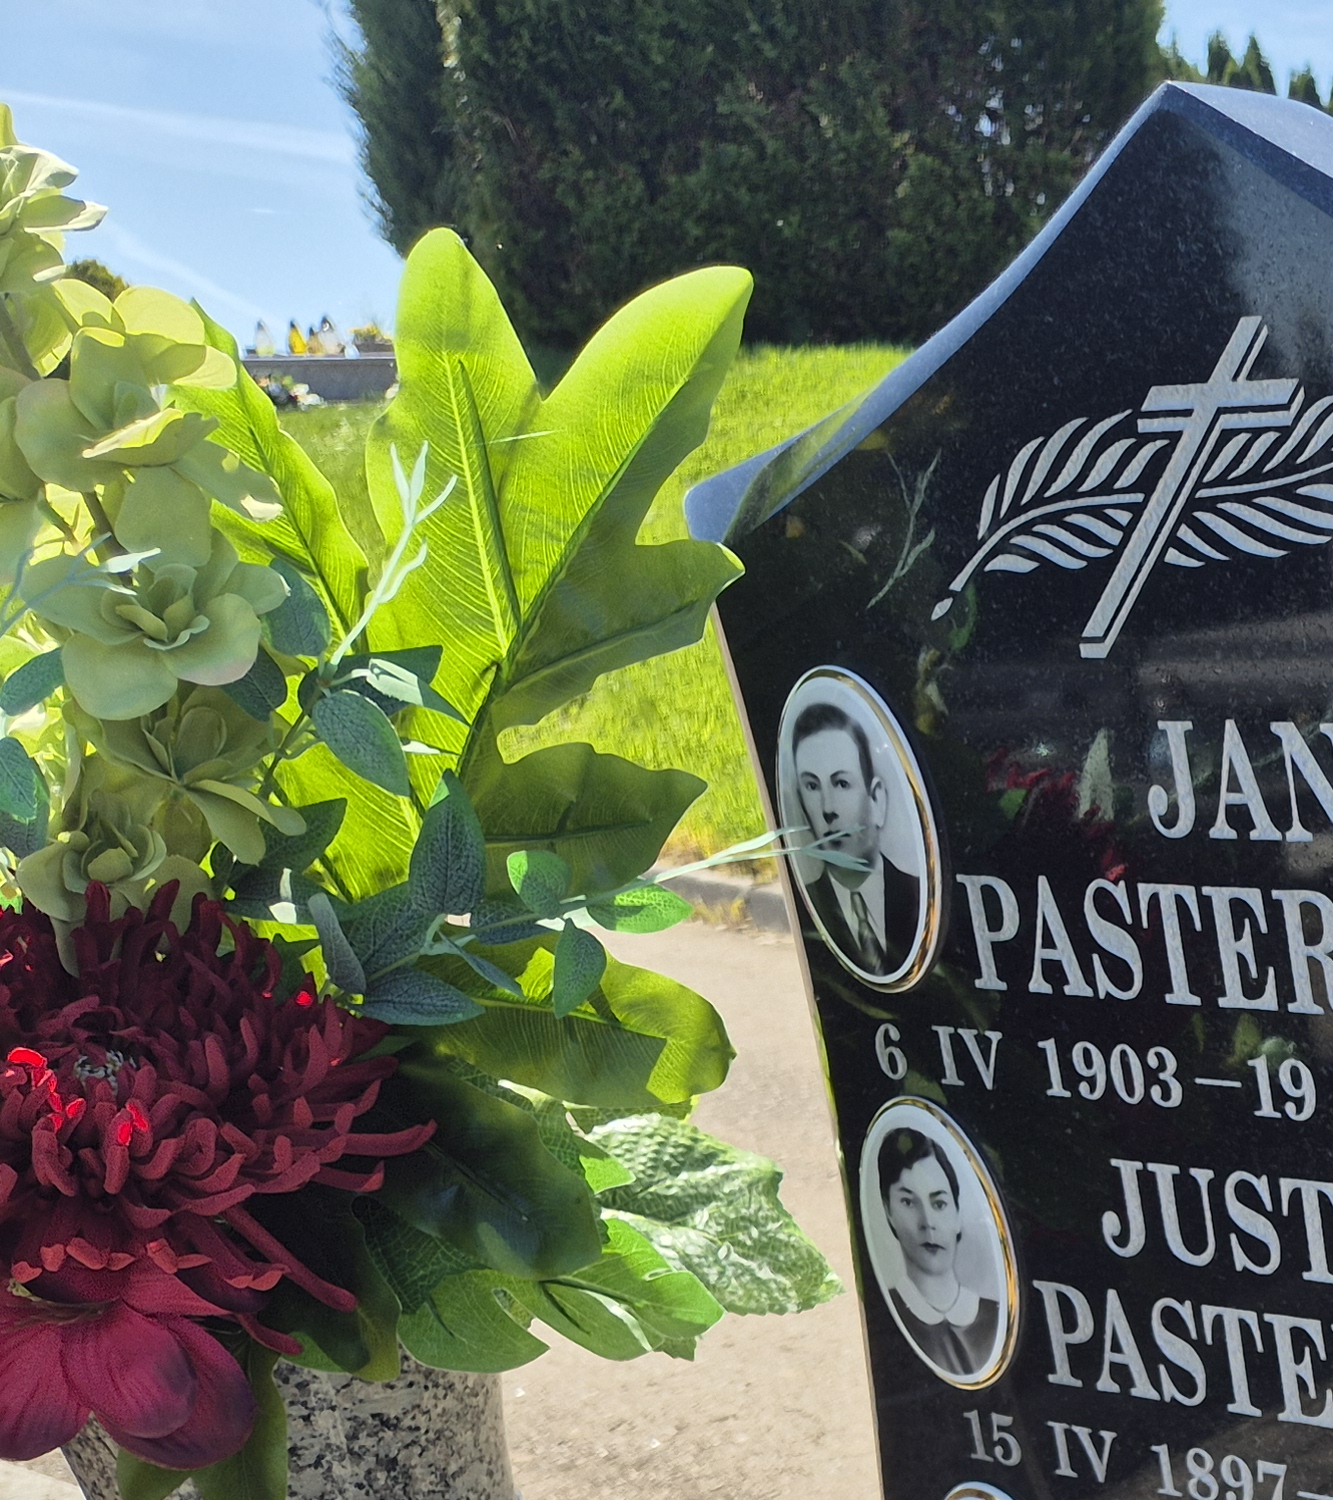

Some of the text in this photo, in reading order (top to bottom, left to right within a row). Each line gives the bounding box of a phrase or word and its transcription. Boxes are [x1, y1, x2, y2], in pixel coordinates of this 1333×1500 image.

[875, 1023, 907, 1080] 6
[931, 1026, 1002, 1090] IV
[963, 1409, 1021, 1466] 15
[1047, 1421, 1117, 1484] IV
